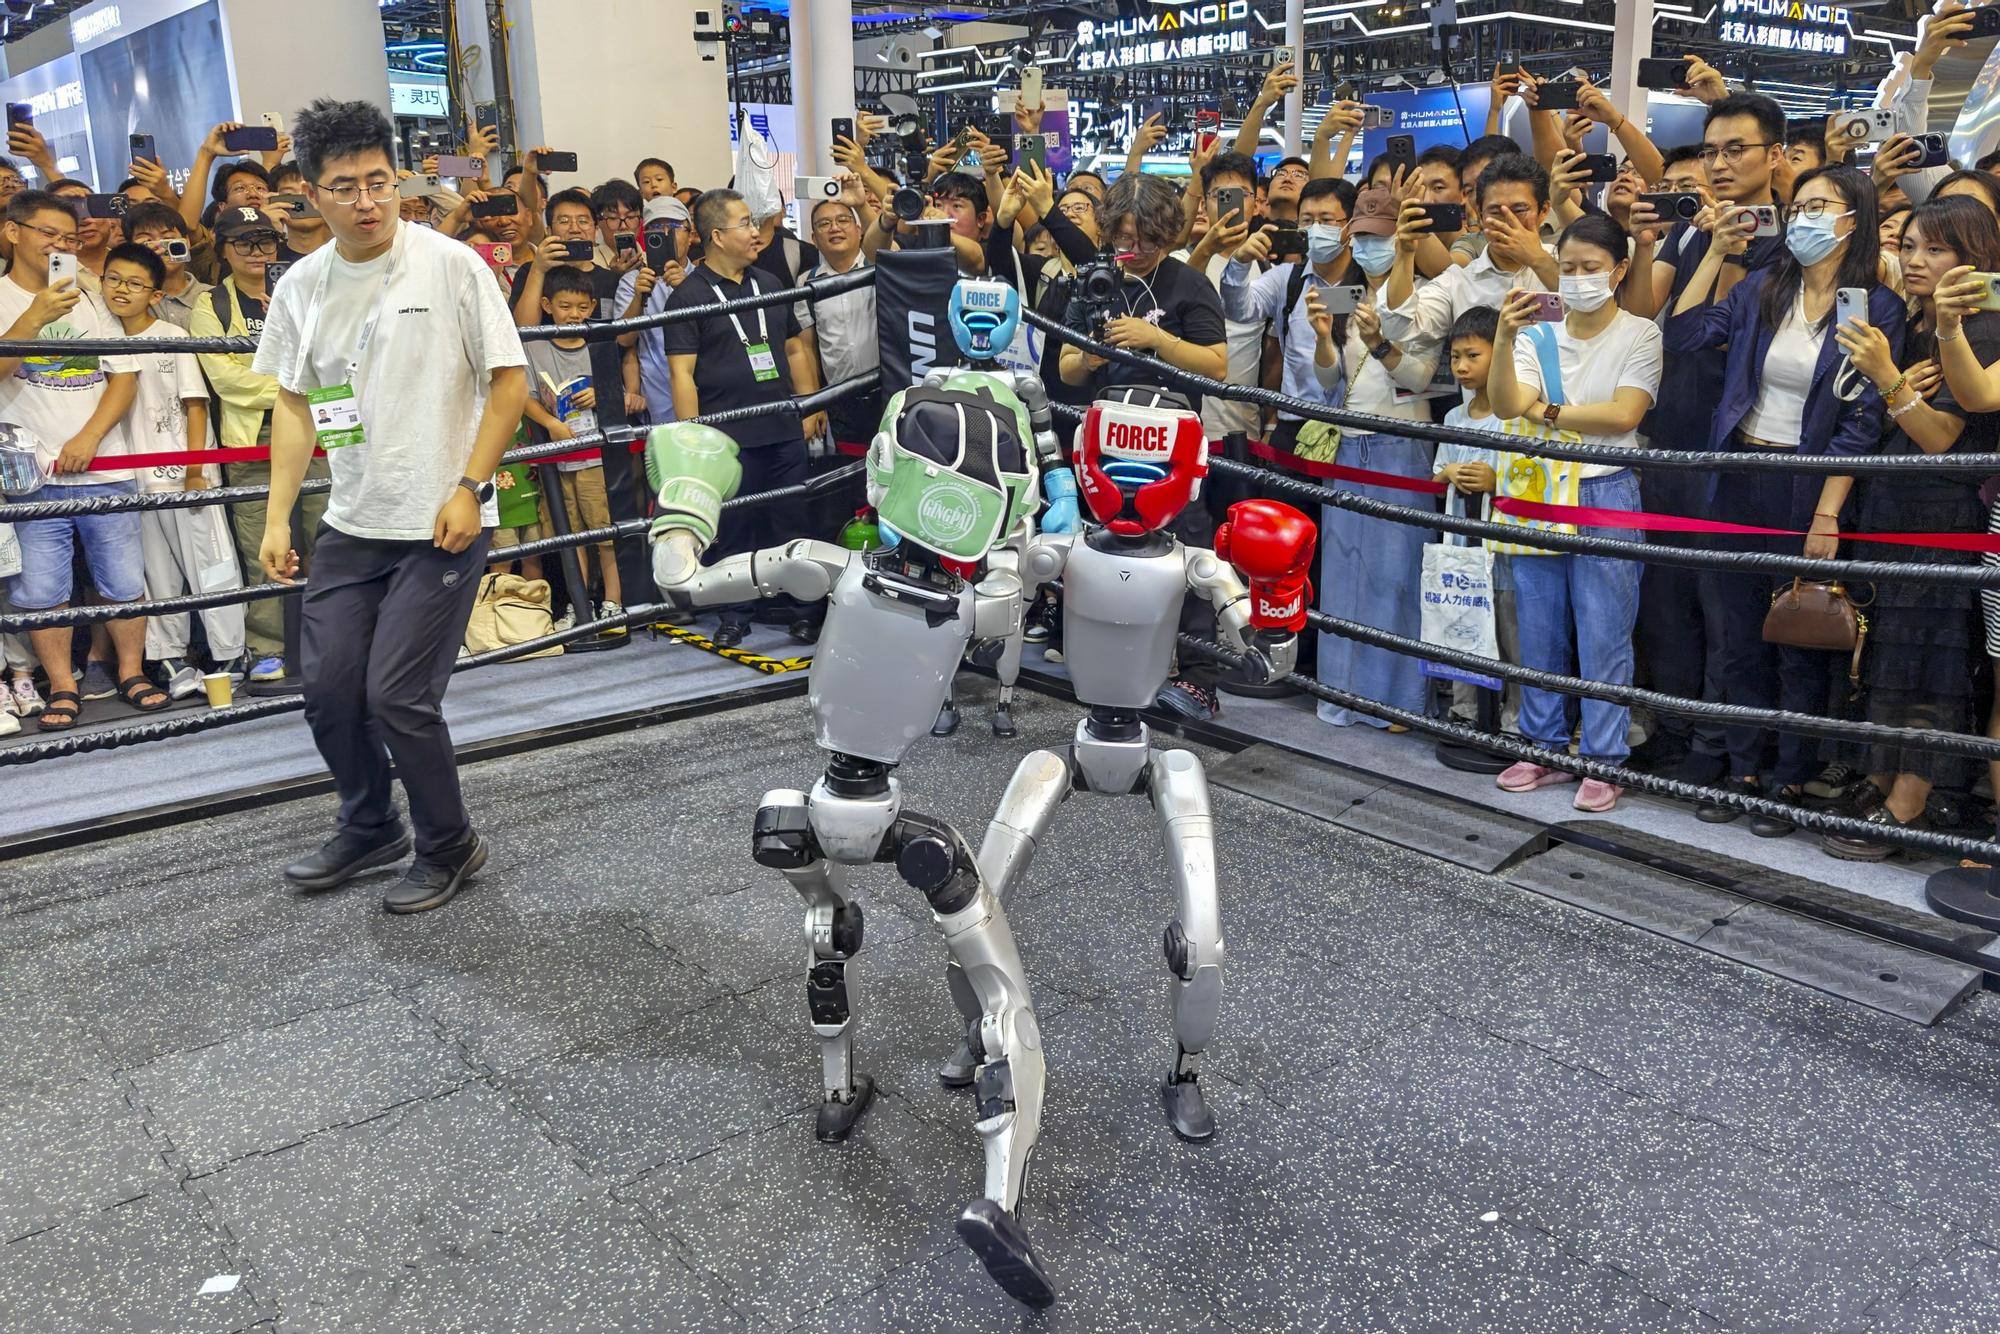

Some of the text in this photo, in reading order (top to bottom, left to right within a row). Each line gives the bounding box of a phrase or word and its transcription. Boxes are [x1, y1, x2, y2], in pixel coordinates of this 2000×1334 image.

[1077, 30, 1248, 71] 北京人形机器人创新中心
[966, 290, 1001, 307] FORCE
[1106, 421, 1168, 452] FORCE
[922, 498, 973, 533] GINGPAI
